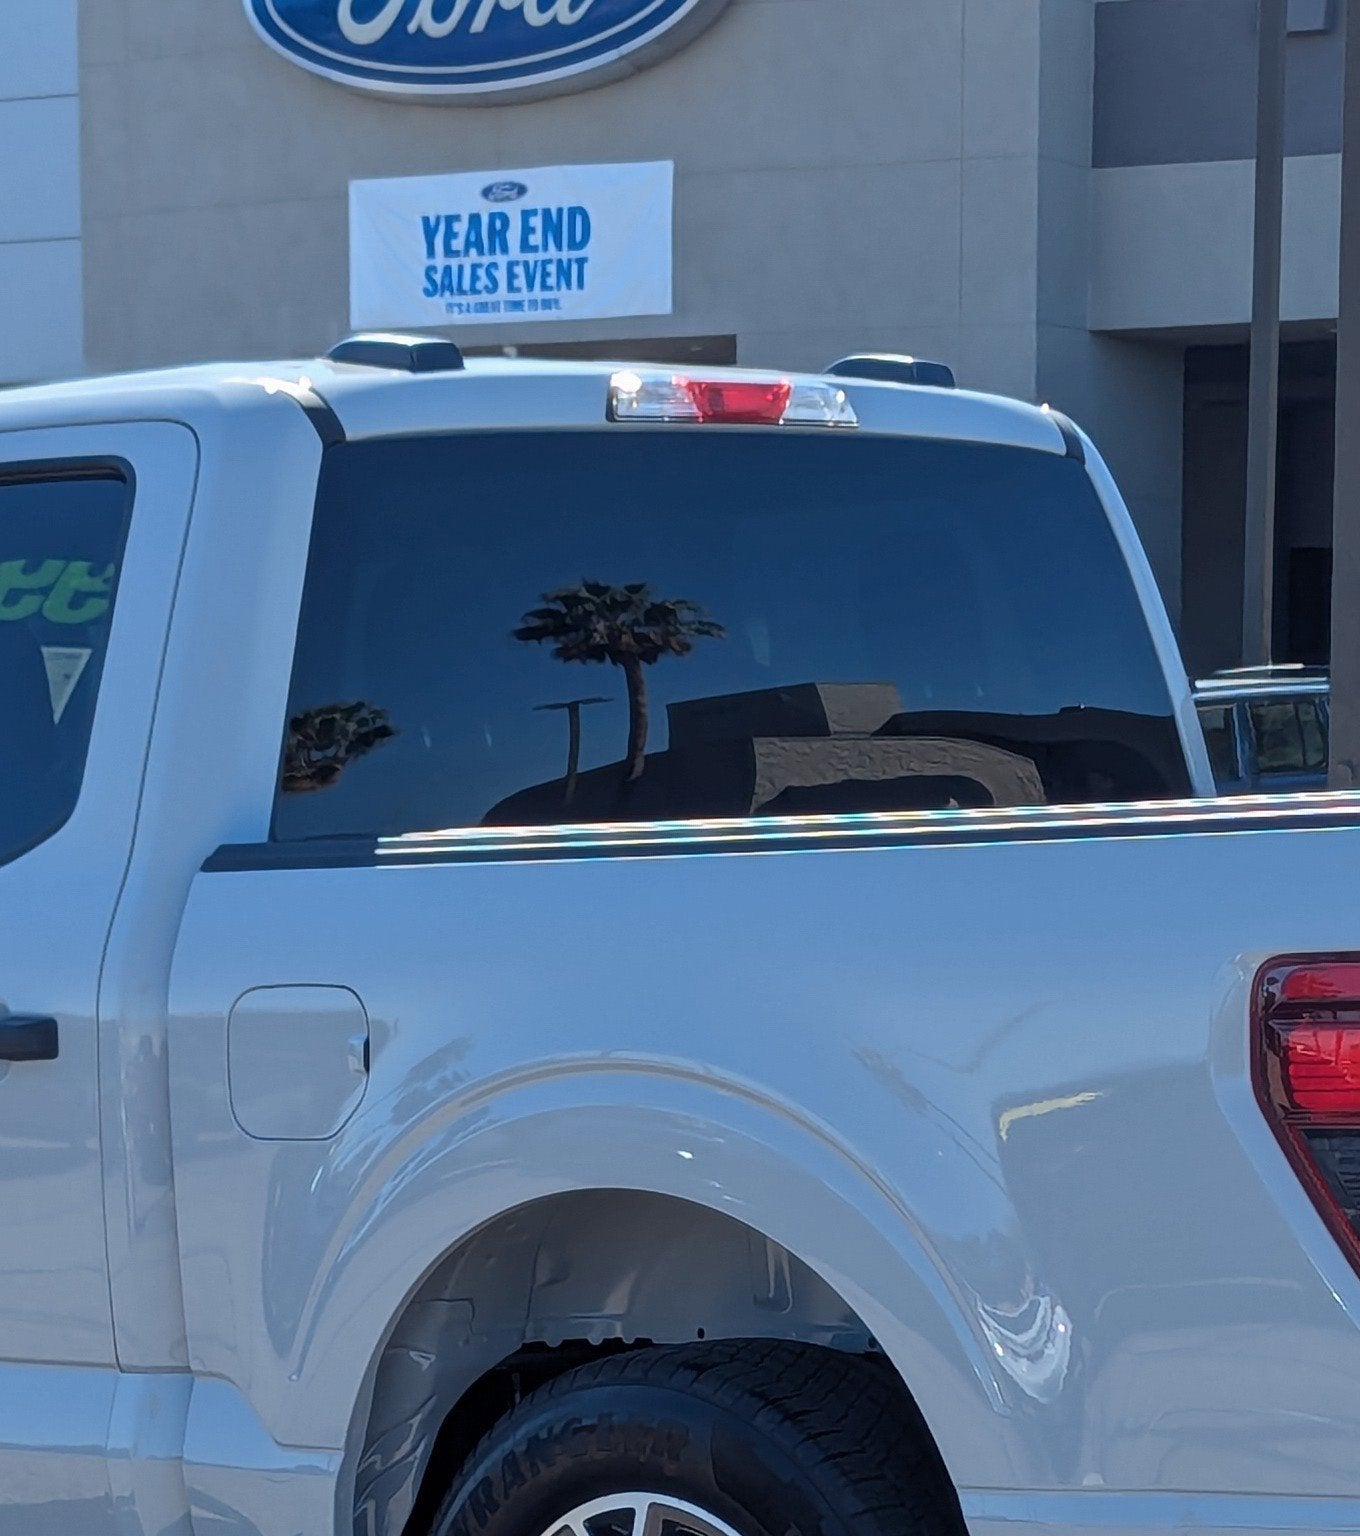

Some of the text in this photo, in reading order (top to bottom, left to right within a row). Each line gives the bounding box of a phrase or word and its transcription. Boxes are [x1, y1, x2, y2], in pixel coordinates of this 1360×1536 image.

[421, 205, 591, 260] YEAR END
[422, 256, 589, 298] SALES EVENT
